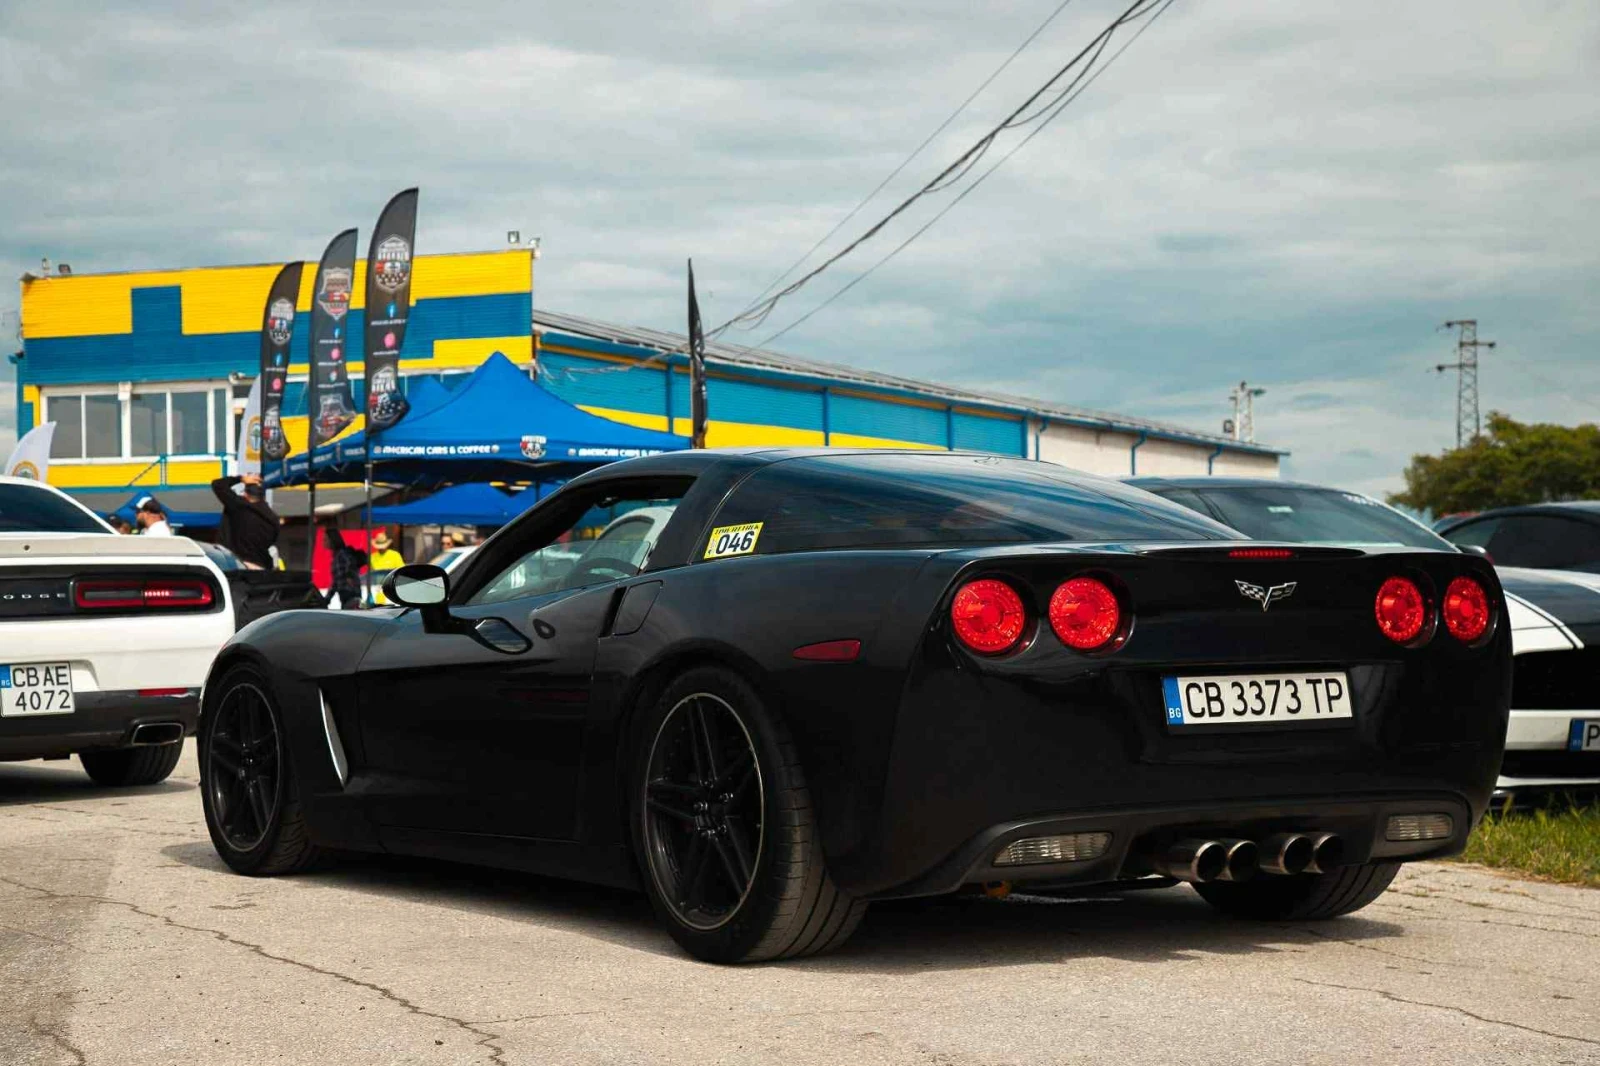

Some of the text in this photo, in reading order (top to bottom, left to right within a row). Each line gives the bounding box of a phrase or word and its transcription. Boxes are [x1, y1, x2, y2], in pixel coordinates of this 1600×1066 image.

[457, 445, 491, 454] COFFEE
[716, 530, 755, 554] 046
[15, 689, 71, 711] 4072
[1185, 677, 1343, 718] CB 3373 TP
[1168, 707, 1182, 719] BG
